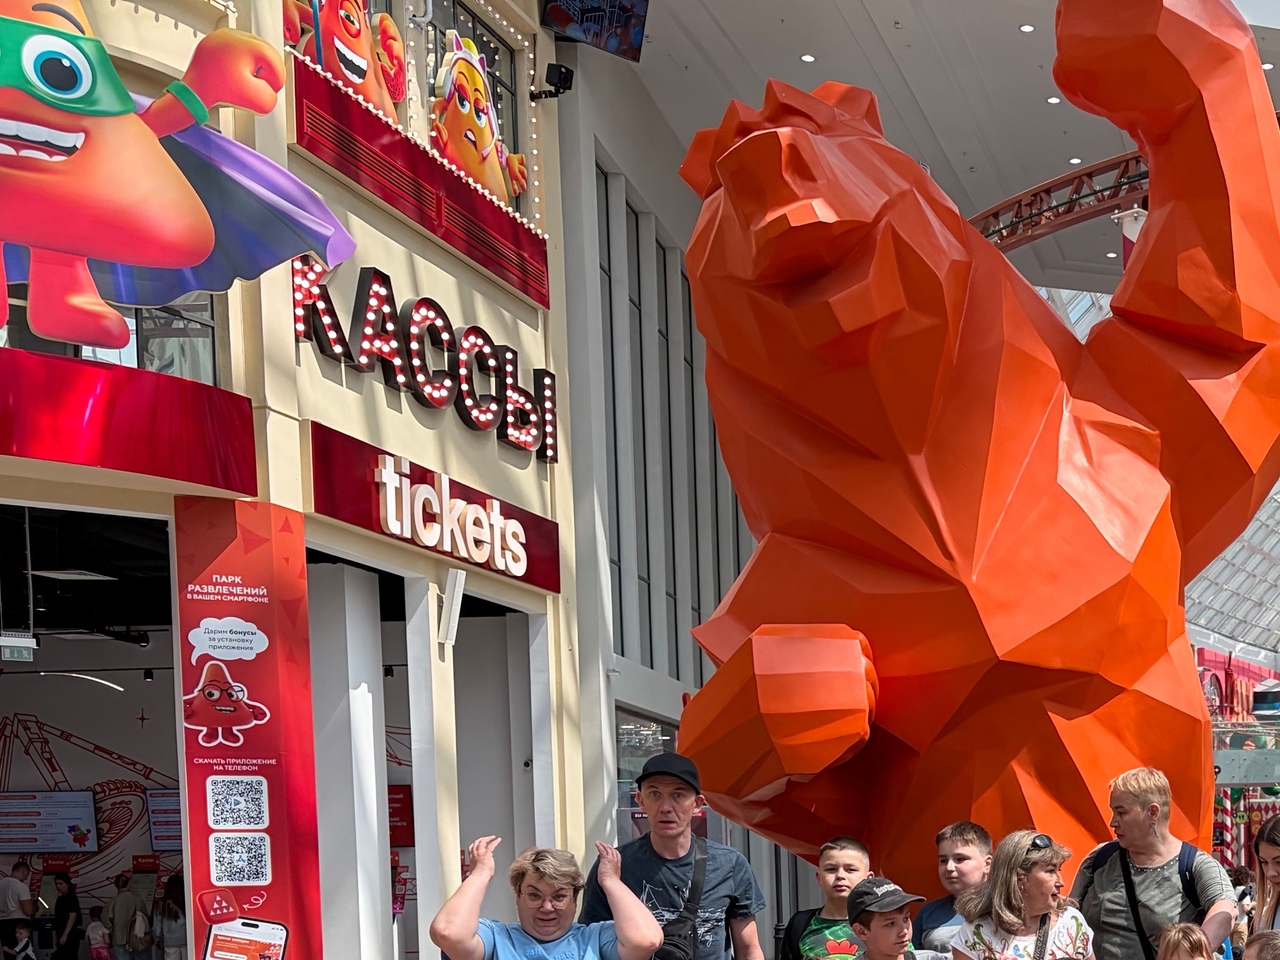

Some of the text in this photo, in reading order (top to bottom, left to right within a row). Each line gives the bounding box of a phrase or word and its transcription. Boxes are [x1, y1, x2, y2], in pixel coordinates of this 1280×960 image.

[291, 254, 558, 464] КАССЫ
[376, 455, 528, 577] tickets
[212, 574, 242, 583] ПАРК
[188, 584, 267, 596] РАЗВЛЕЧЕНИЙ
[222, 595, 269, 603] СМАРТФОНЕ
[204, 628, 257, 637] Дарим бонусы
[217, 637, 253, 645] установку
